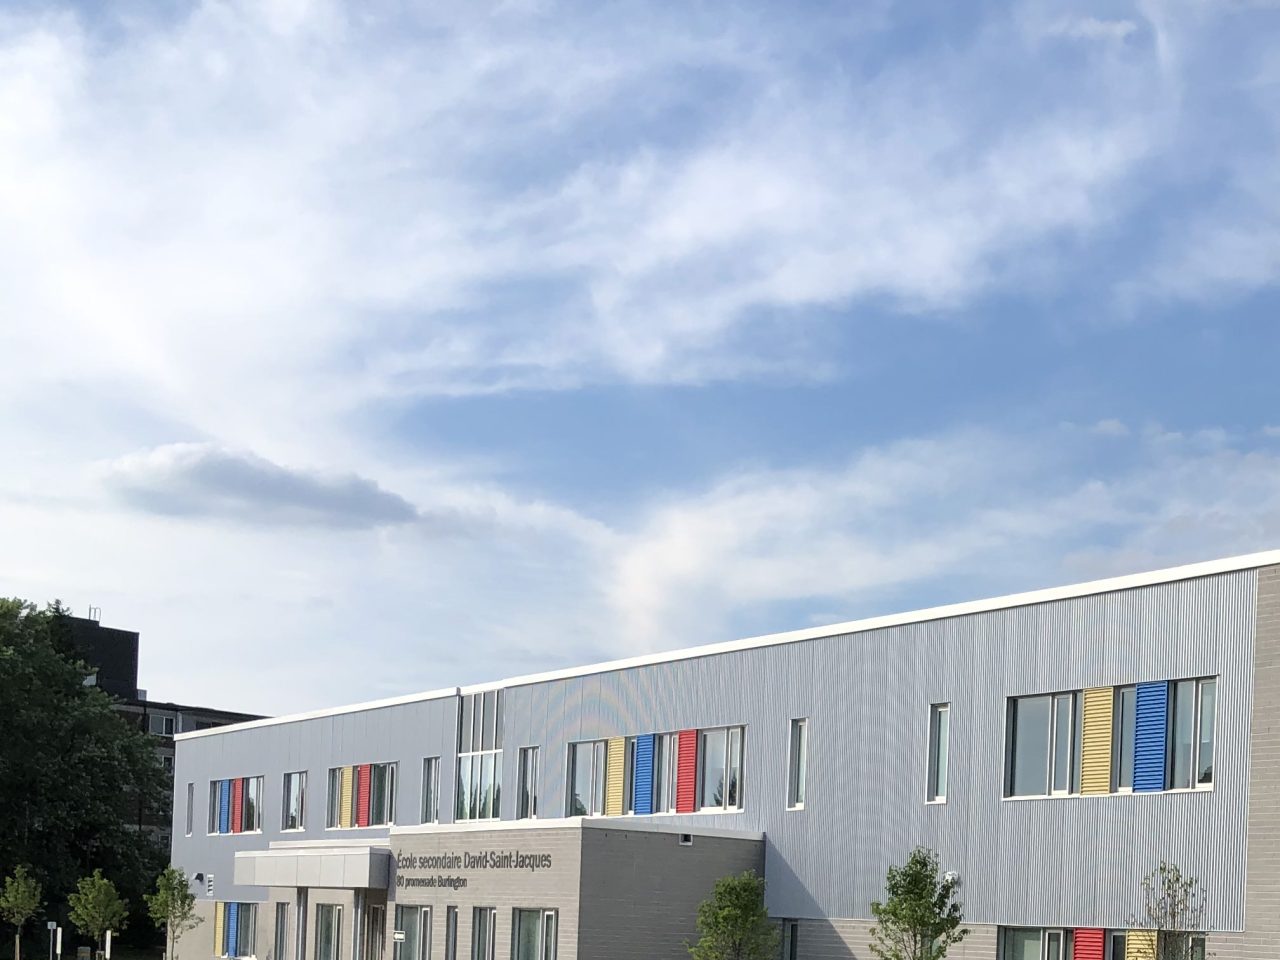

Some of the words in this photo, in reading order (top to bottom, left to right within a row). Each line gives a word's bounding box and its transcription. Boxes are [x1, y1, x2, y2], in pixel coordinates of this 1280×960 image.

[397, 850, 418, 869] École
[419, 852, 461, 869] secondaire
[464, 851, 551, 871] David-Saint-Jacques
[397, 875, 404, 887] 80
[405, 876, 437, 889] promenade
[438, 876, 467, 890] Burlington
